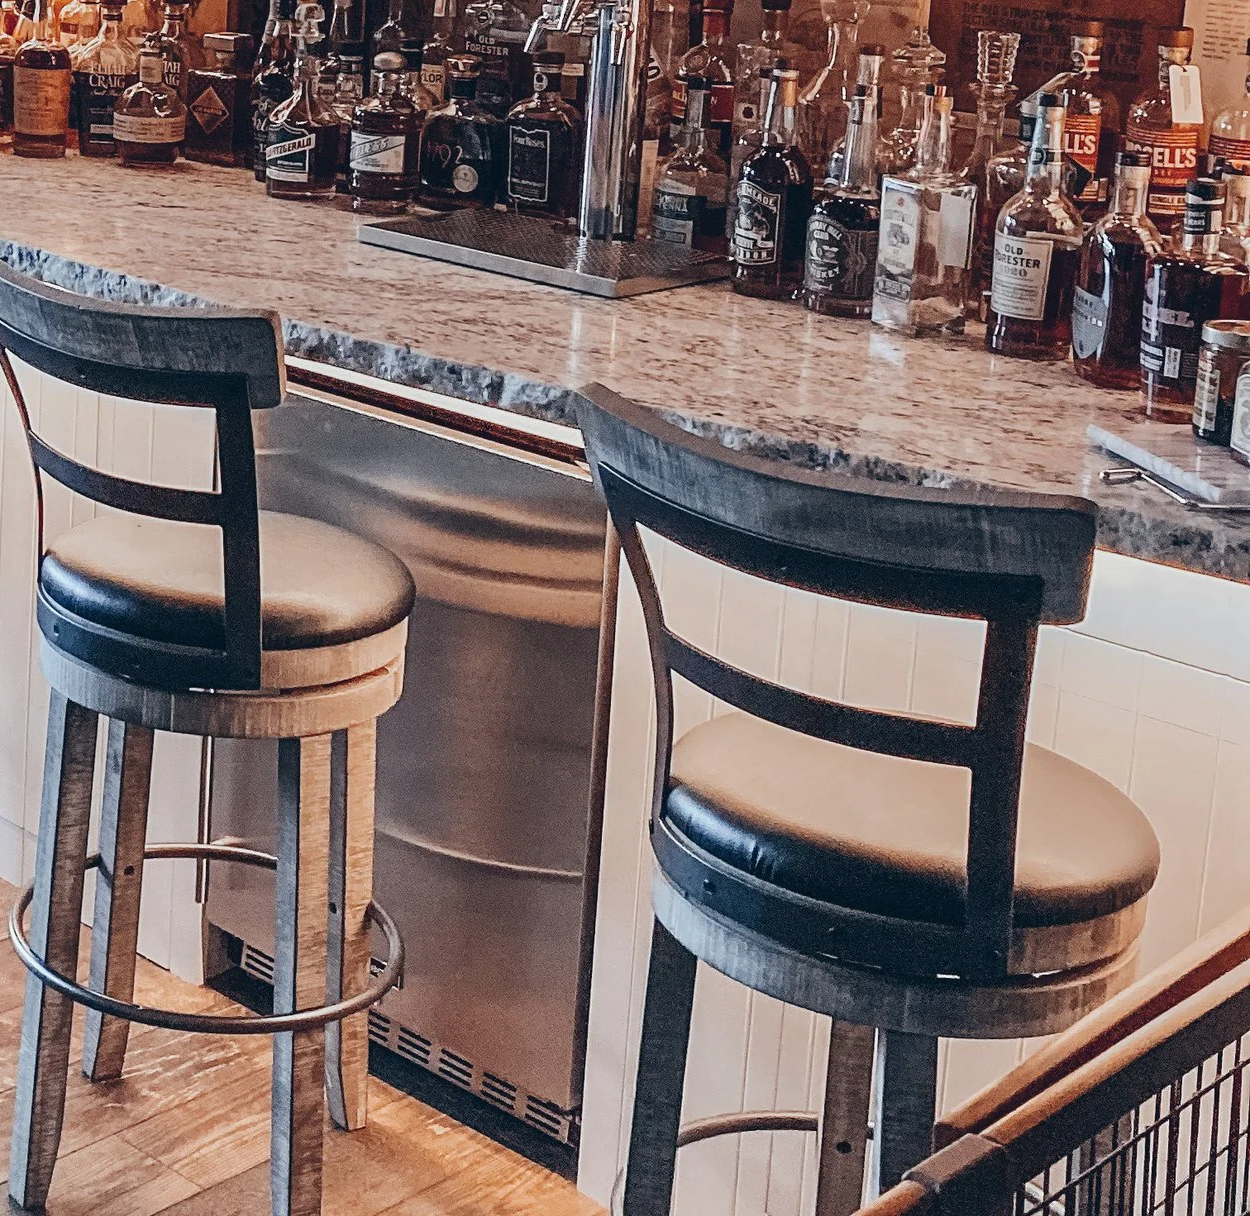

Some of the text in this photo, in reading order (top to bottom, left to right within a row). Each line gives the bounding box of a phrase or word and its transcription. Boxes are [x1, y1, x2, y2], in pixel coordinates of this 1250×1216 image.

[477, 34, 495, 45] OLD
[465, 40, 510, 56] FORESTER
[89, 74, 126, 88] CRAIG
[1005, 243, 1024, 256] OLD
